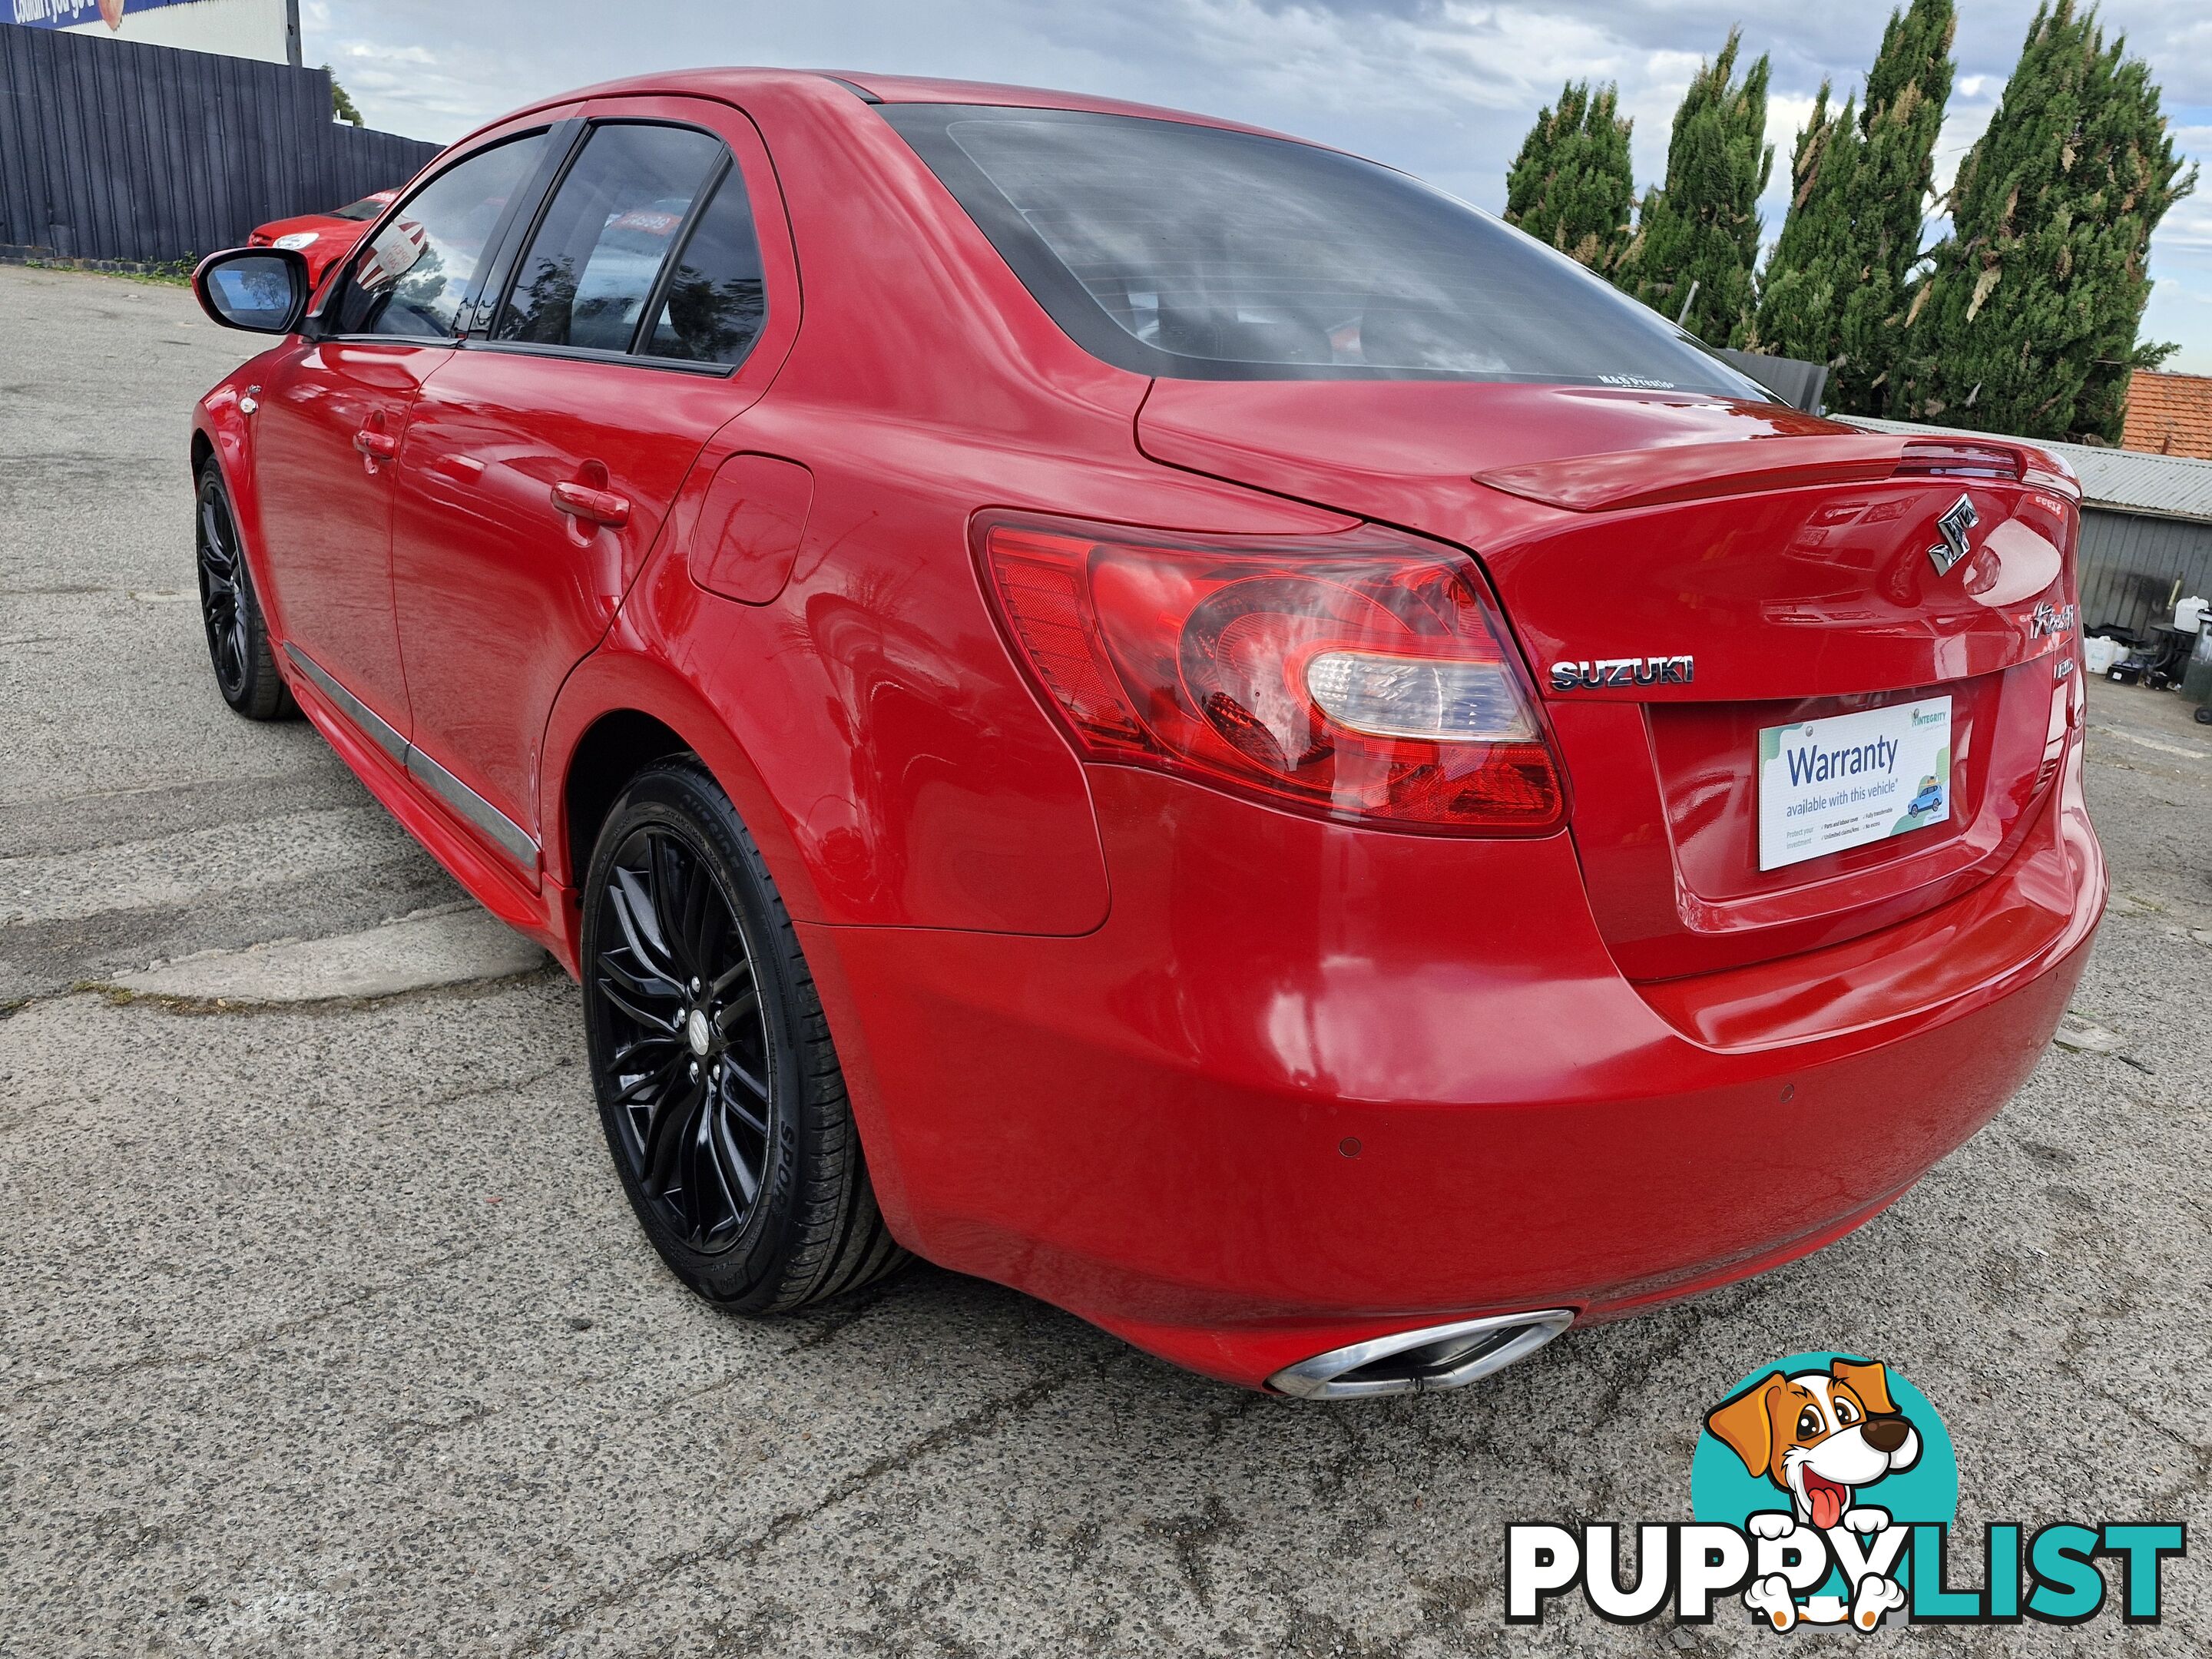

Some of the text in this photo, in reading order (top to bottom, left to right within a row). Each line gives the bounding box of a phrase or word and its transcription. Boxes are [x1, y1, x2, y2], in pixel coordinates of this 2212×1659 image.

[12, 0, 51, 24] Couldnt
[1551, 655, 1694, 690] SUZUKI
[1917, 711, 1946, 726] INTEGRITY
[1787, 734, 1899, 787] Warranty
[1786, 796, 1826, 816] available
[1829, 790, 1848, 806] with
[1850, 786, 1865, 802] this
[1786, 827, 1813, 839] Protect your
[1786, 838, 1812, 849] investment
[773, 1120, 795, 1208] SPOR
